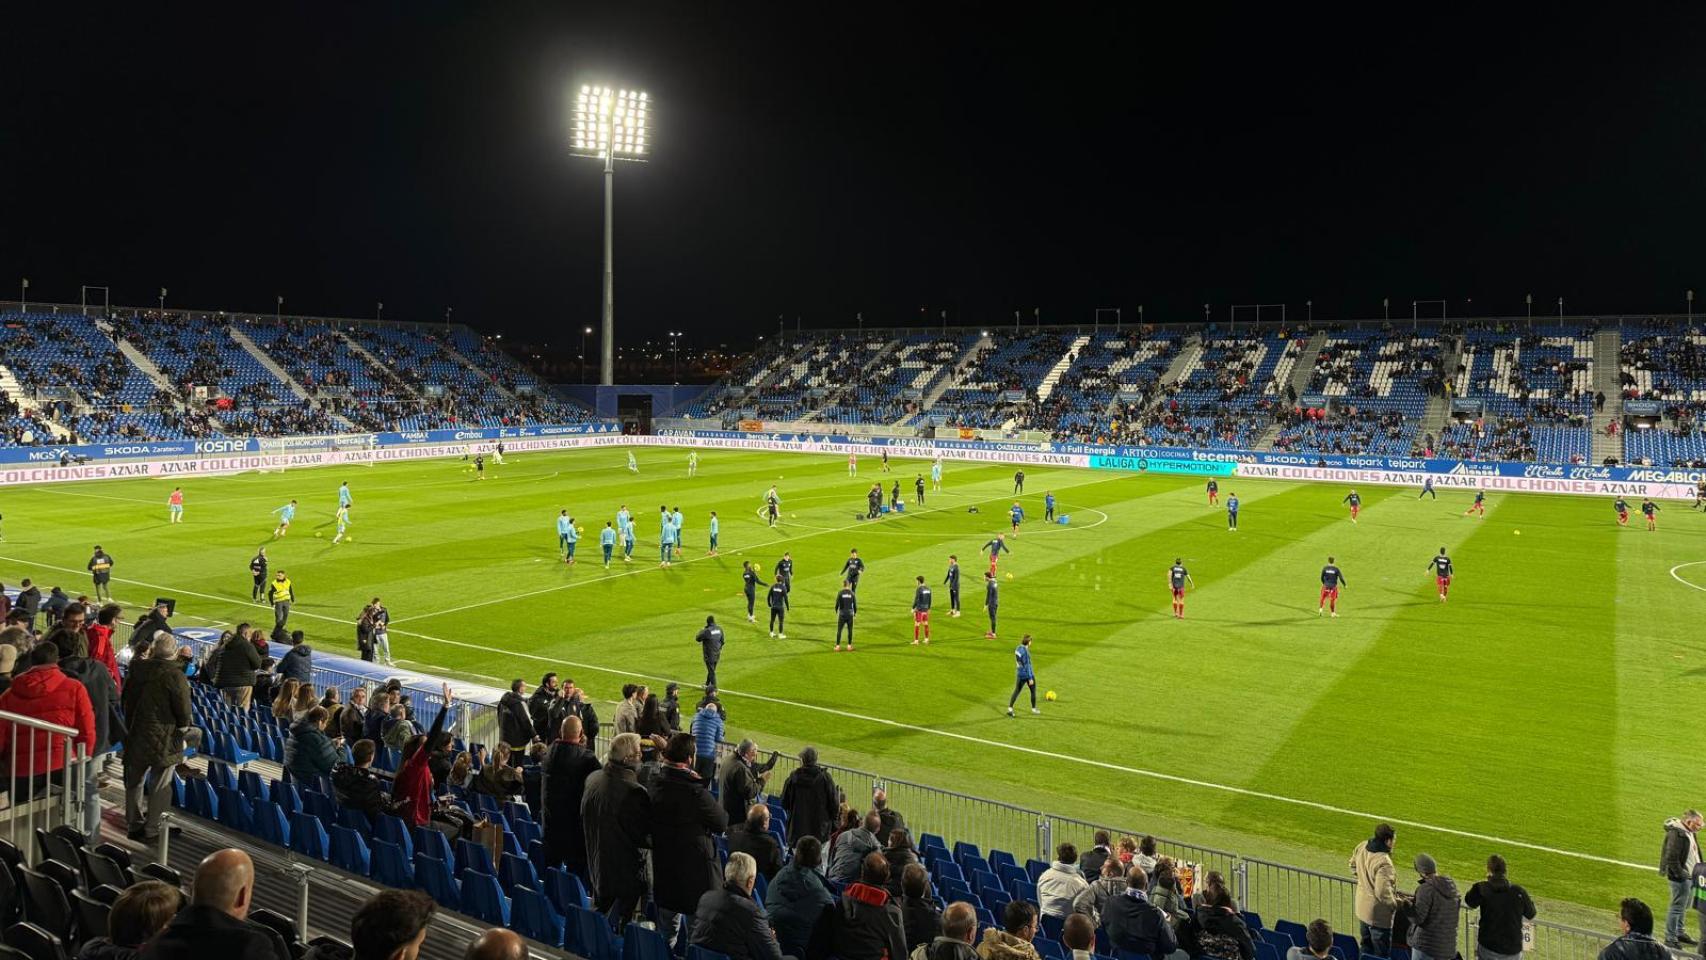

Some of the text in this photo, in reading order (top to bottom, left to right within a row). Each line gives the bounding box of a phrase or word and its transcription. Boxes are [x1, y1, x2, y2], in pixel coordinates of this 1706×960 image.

[455, 431, 483, 440] embou
[658, 429, 696, 437] CARAVAN
[194, 439, 250, 453] kosner
[725, 439, 779, 449] COLCHONES
[820, 443, 932, 456] AZNAR COLCHONES AZNAR
[887, 439, 936, 448] CARAVAN
[1067, 445, 1082, 453] Full
[29, 452, 56, 461] MGS
[104, 446, 150, 455] SKODA
[376, 448, 445, 460] COLCHONES
[1122, 448, 1190, 458] ARTICO COCINAS
[941, 449, 1071, 465] AZNAR COLCHONES AZNAR
[1264, 455, 1308, 464] SKODA
[1346, 456, 1426, 469] telpark telpark
[160, 454, 322, 473] AZNAR COLCHONES AZNAR
[1099, 456, 1219, 472] LALIGA HYPERMOTION
[0, 464, 149, 482] OLCHONES AZNAR
[1242, 466, 1423, 484] AZNAR COLCHONES AZNAR
[1434, 475, 1647, 495] AZNAR COLCHONES AZNAR
